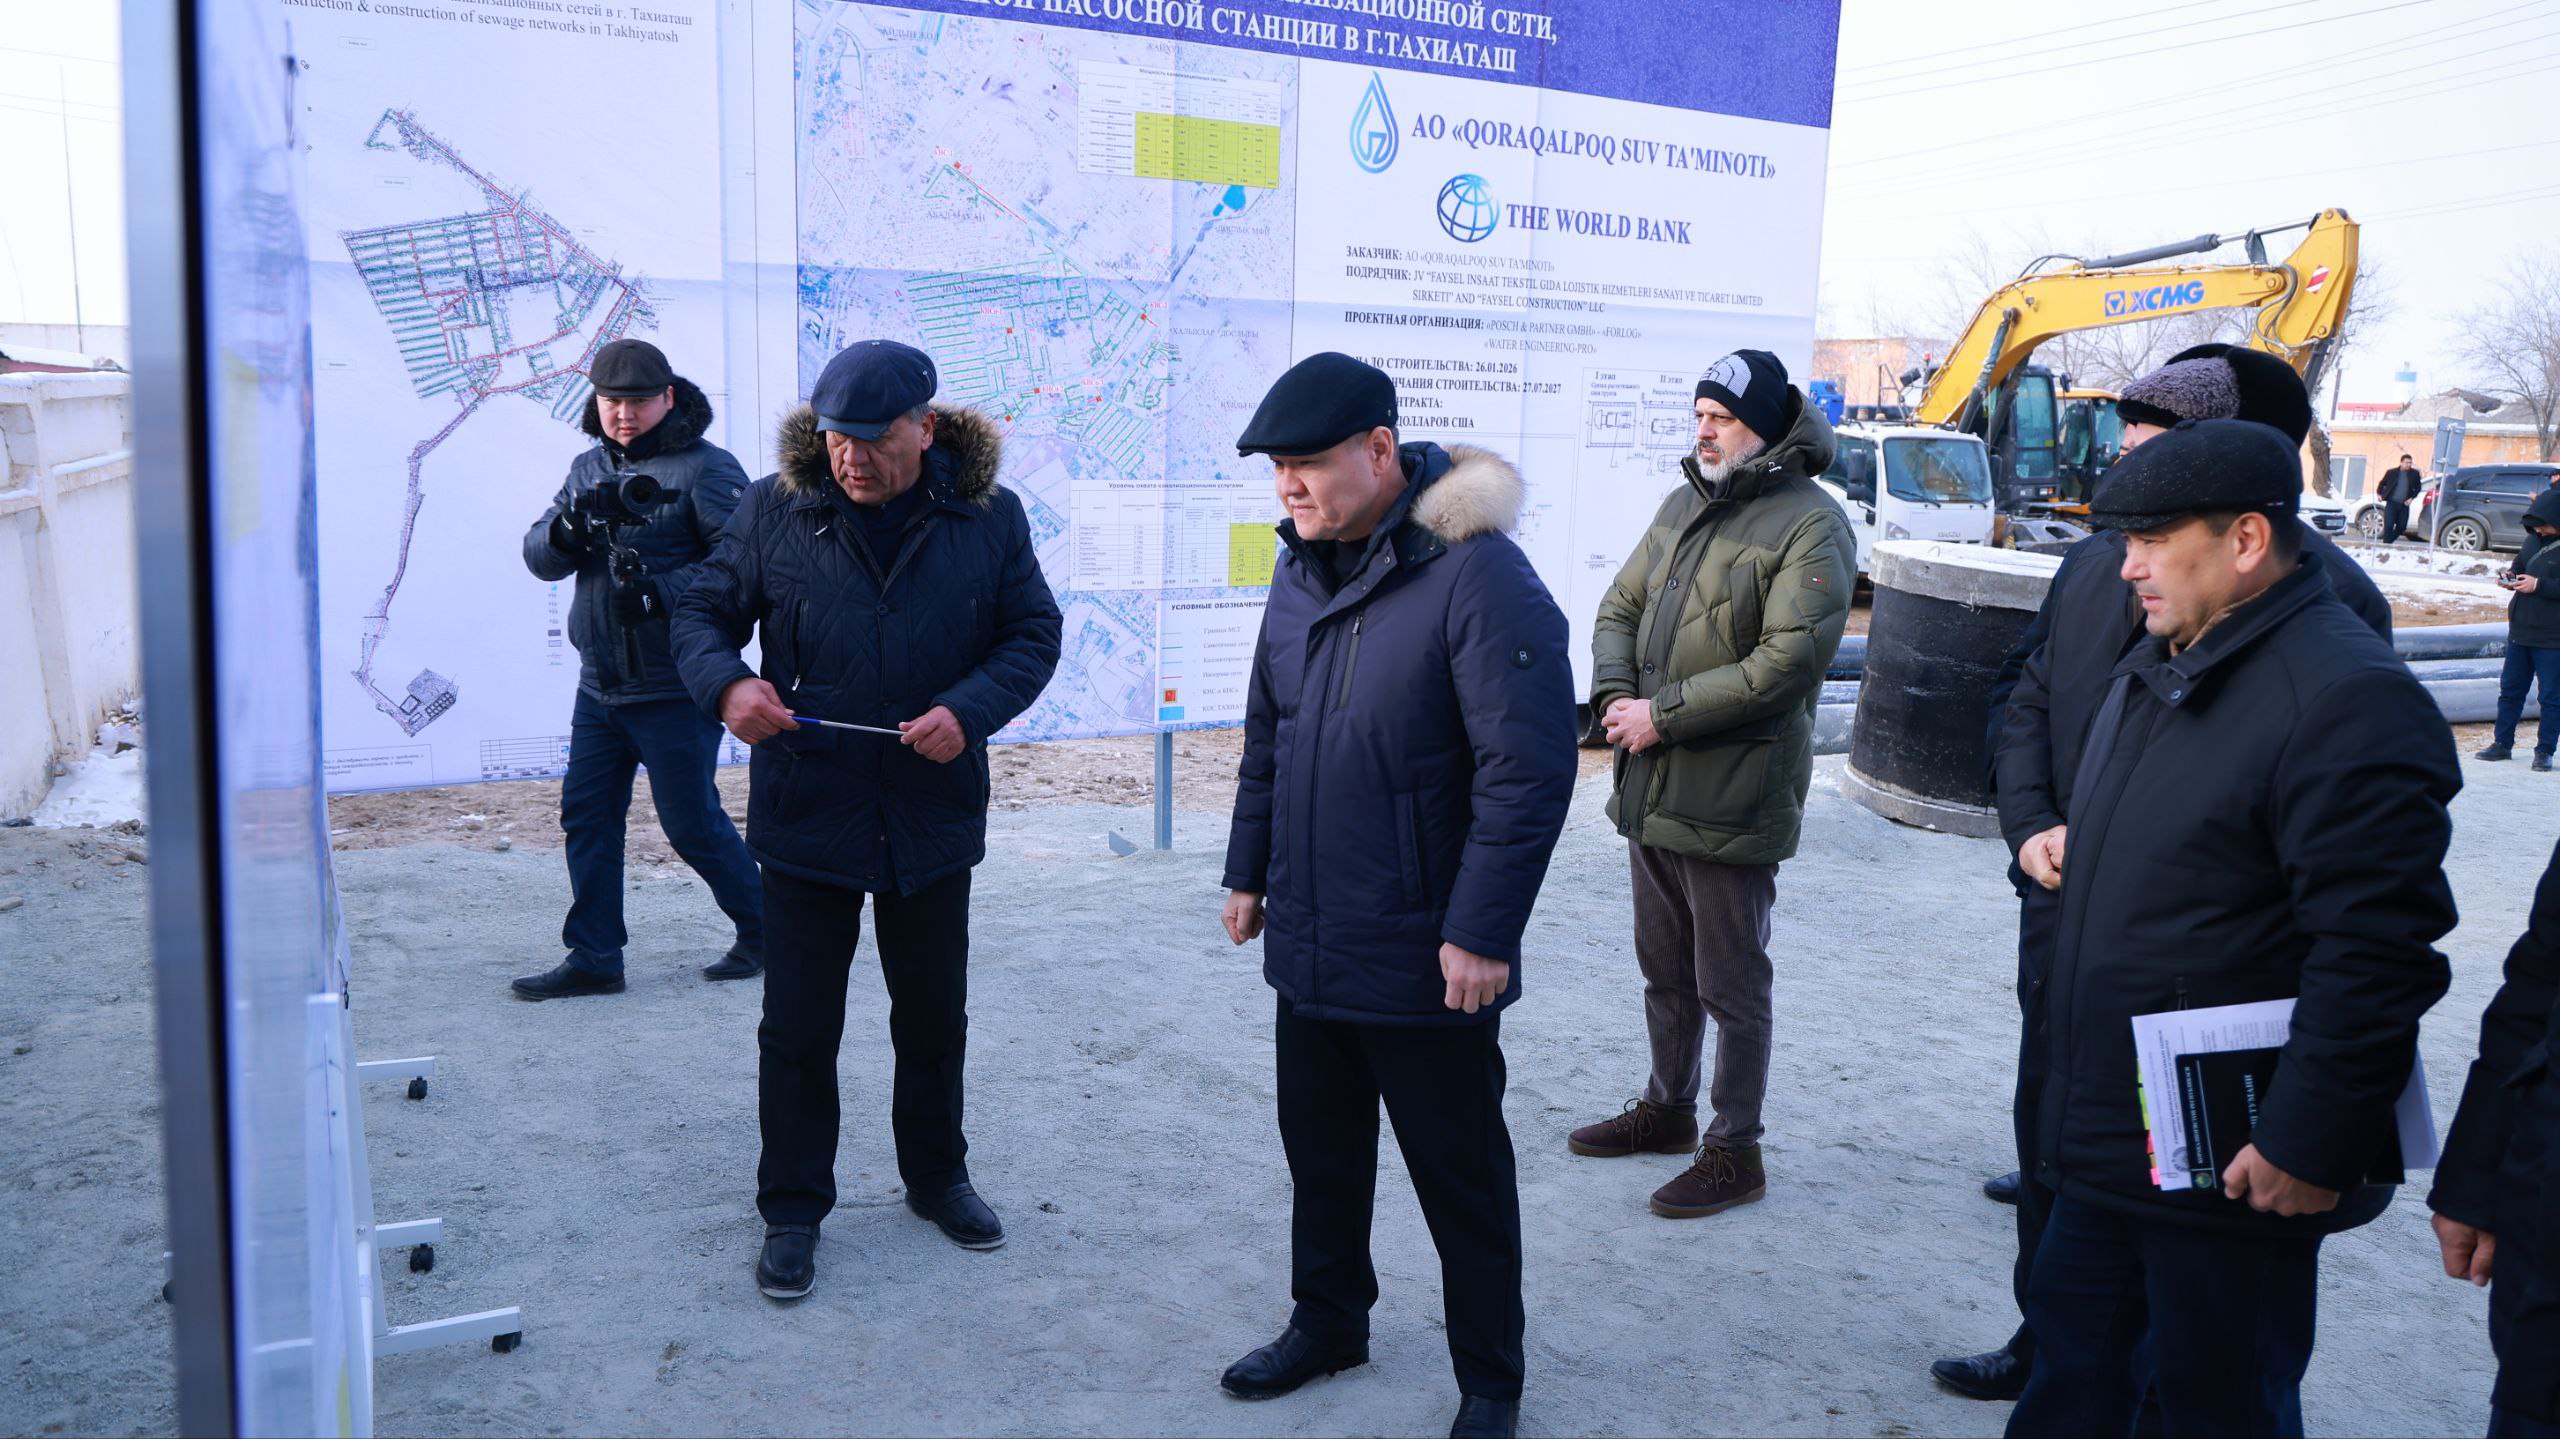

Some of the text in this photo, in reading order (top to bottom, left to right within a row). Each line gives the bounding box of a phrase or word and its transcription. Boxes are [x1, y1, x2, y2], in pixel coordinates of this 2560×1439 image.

[357, 1, 371, 13] &
[375, 3, 456, 21] construction
[460, 9, 474, 22] of
[478, 13, 525, 30] sewage
[529, 19, 585, 34] networks
[589, 24, 600, 36] in
[605, 23, 679, 43] Takhiyatosh
[566, 3, 601, 17] сетей
[606, 8, 613, 18] в
[617, 9, 626, 20] г.
[631, 7, 692, 26] Тахиаташ
[1491, 9, 1557, 45] СЕТИ,
[1211, 7, 1337, 50] СТАНЦИИ
[1344, 26, 1359, 51] В
[1365, 28, 1516, 72] Г.ТАХИАТАШ
[1452, 118, 1616, 165] «QORAQALPOQ
[1621, 138, 1660, 165] SUV
[1664, 143, 1776, 179] TA'MINOTI»
[1506, 203, 1691, 244] THE WORLD BANK
[1346, 246, 1402, 261] ЗАКАЗЧИК:
[1420, 250, 1487, 268] «QORAQALPOQ
[1489, 256, 1507, 269] SUV
[1346, 265, 1411, 281] ПОДРЯДЧИК:
[1413, 270, 1424, 282] JV
[1467, 274, 1499, 287] INSAAT
[1501, 277, 1538, 290] TEKSTIL
[1539, 279, 1561, 291] GIDA
[1563, 281, 1600, 295] LOJISTIK
[1602, 284, 1651, 299] HIZMETLERI
[1685, 290, 1696, 302] VE
[1698, 291, 1730, 305] TICARET
[1731, 293, 1763, 307] LIMITED
[2128, 280, 2205, 313] XCMG
[1456, 292, 1475, 304] AND
[1589, 302, 1606, 313] LLC
[1344, 311, 1407, 326] ПРОЕКТНАЯ
[1410, 315, 1484, 331] ОРГАНИЗАЦИЯ:
[1521, 322, 1527, 333] &
[1529, 323, 1565, 335] PARTNER
[1386, 357, 1473, 372] СТРОИТЕЛЬСТВА:
[1476, 362, 1518, 374] 26.01.2026
[1600, 373, 1616, 381] этап
[1436, 379, 1521, 393] СТРОИТЕЛЬСТВА:
[1523, 382, 1562, 395] 27.07.2027
[1667, 376, 1683, 384] этап
[1396, 396, 1443, 409] НТРАКТА:
[1451, 416, 1475, 429] США
